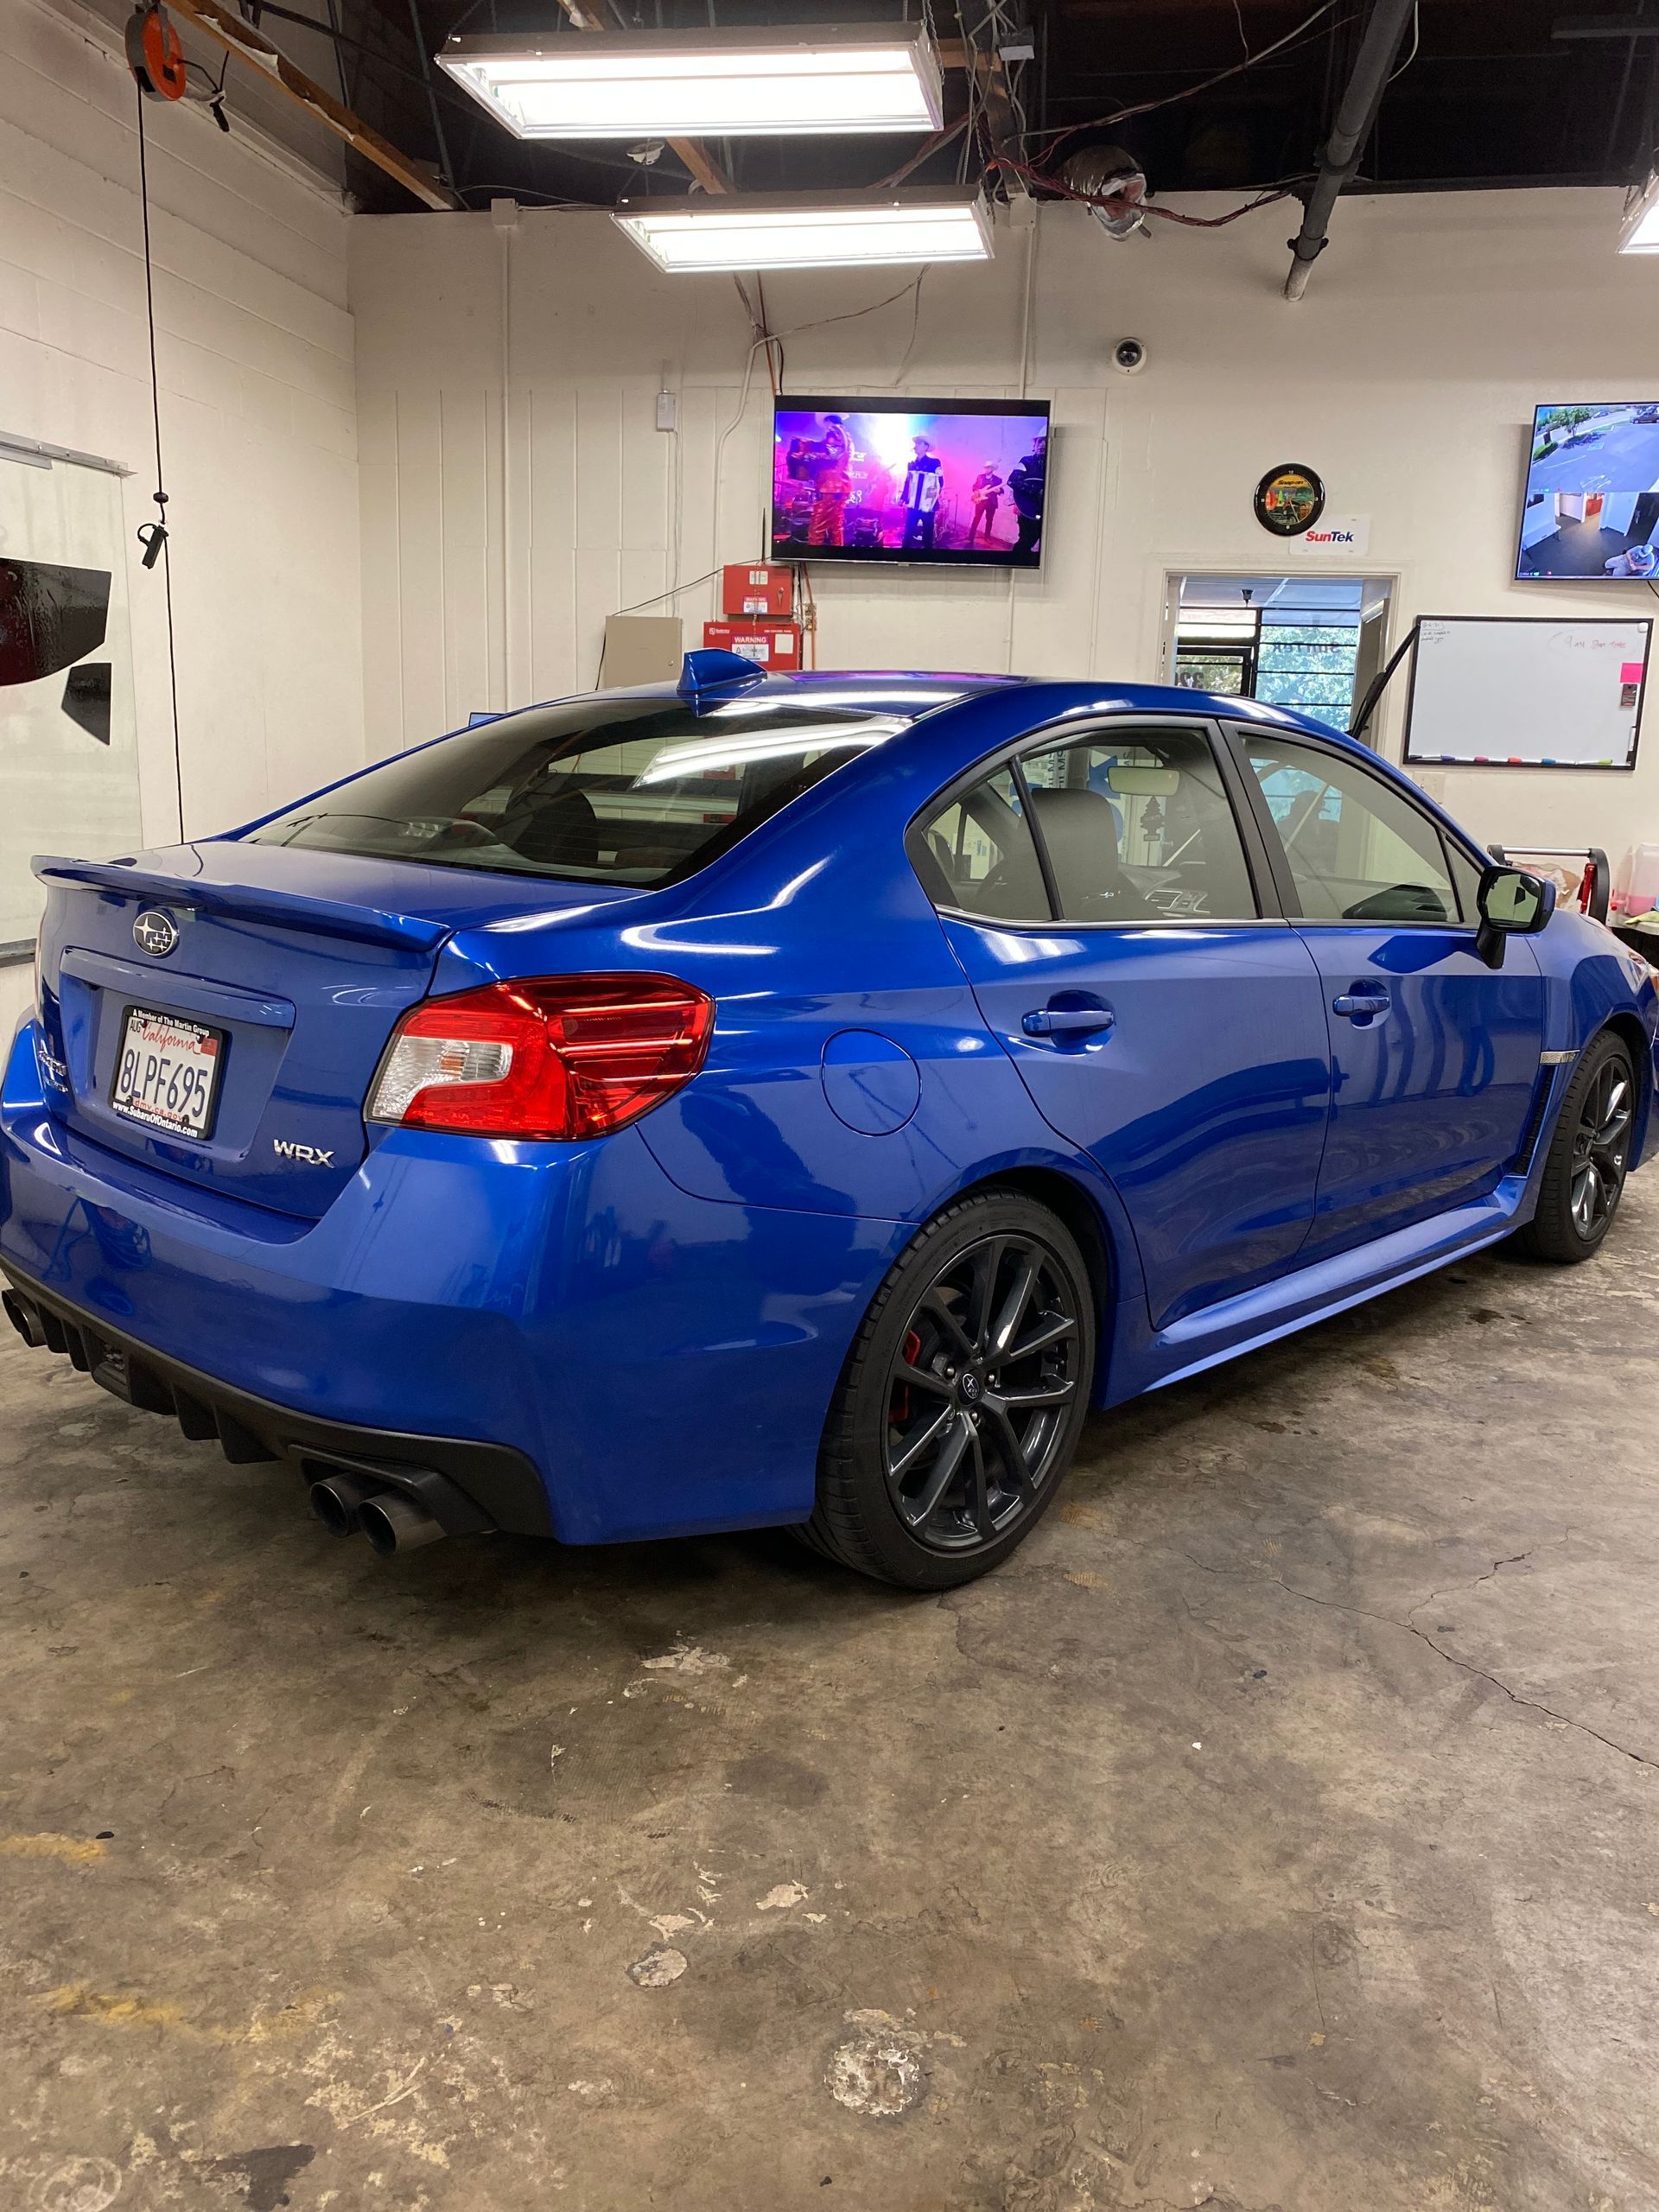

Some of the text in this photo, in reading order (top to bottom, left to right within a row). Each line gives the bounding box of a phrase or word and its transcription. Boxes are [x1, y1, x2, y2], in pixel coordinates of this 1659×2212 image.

[1305, 531, 1354, 543] SunTek
[133, 1008, 210, 1037] A Member of The Martin Group
[142, 1020, 201, 1055] California
[120, 1048, 208, 1118] 8LPF695
[112, 1101, 198, 1138] www.SubaruOfOntario.com
[135, 1100, 182, 1121] dmv.ca.gov
[273, 1139, 336, 1169] WRX
